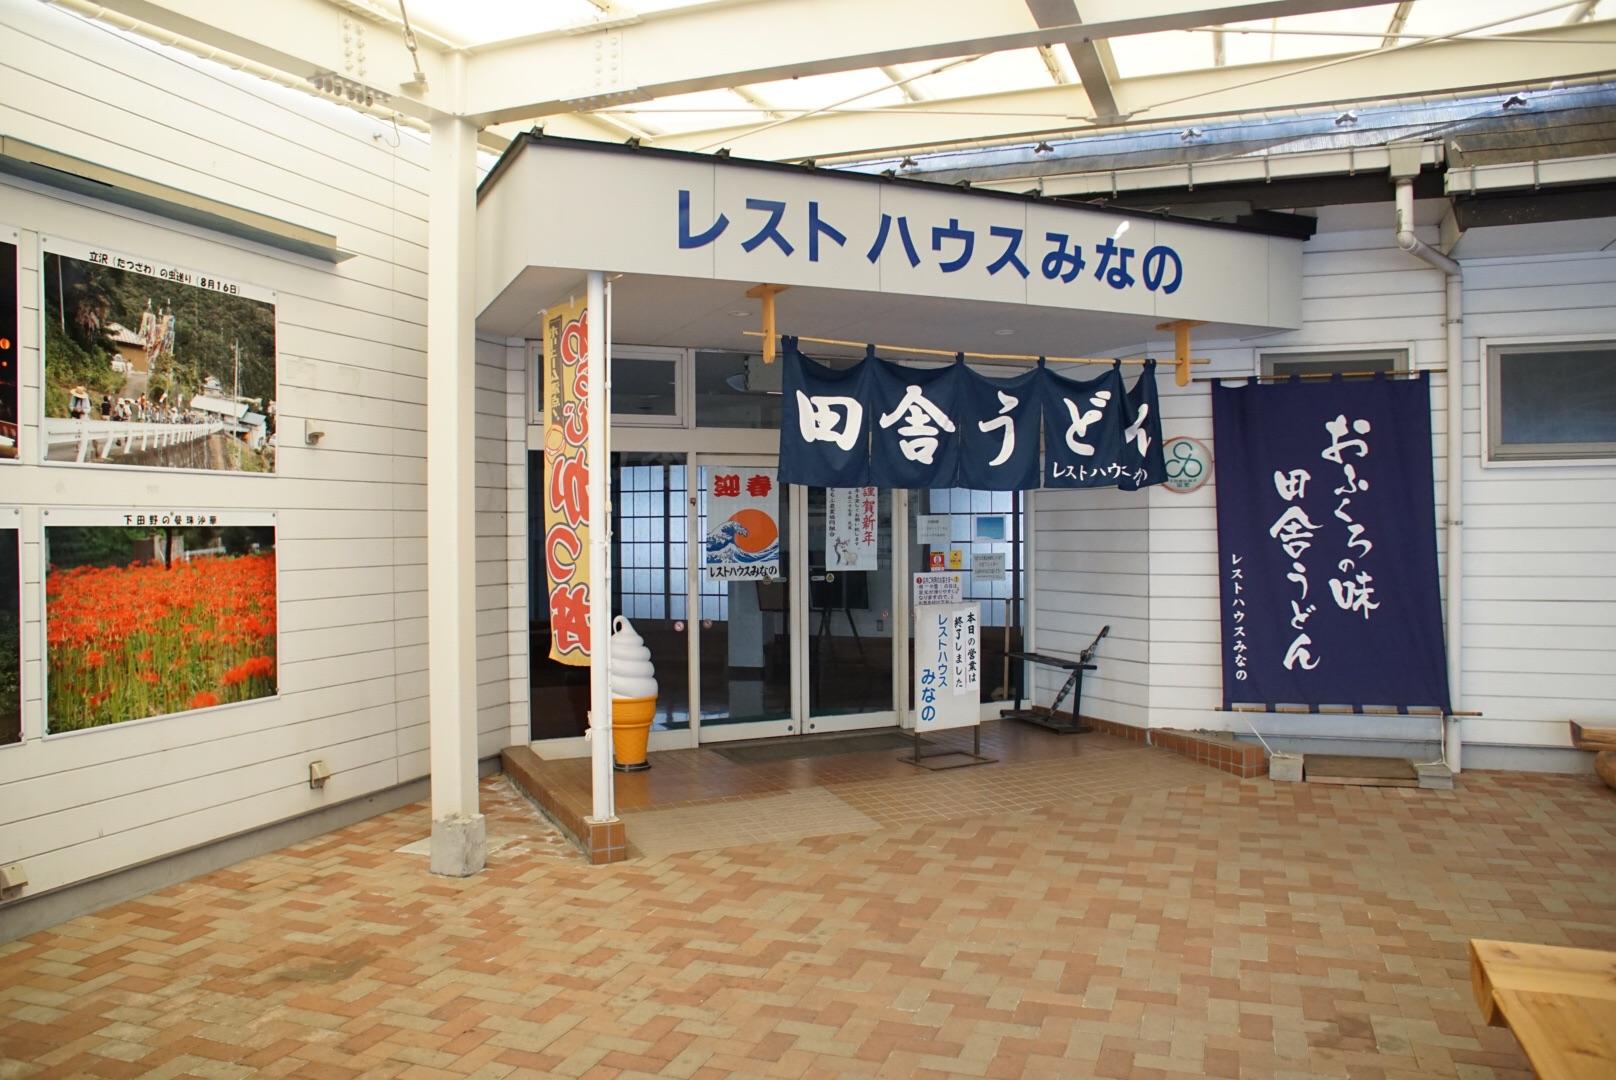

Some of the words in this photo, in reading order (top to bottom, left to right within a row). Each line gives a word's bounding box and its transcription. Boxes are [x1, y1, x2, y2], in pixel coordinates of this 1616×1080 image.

[678, 189, 1183, 295] レストハウスみなの
[713, 474, 772, 498] 迎春
[1322, 414, 1380, 620] おふくろの味
[710, 565, 778, 578] レストハウスみなの
[1269, 468, 1324, 671] 田舎うどん
[938, 614, 948, 687] レストハウス
[954, 616, 964, 688] 終了しました
[966, 611, 977, 683] 本日の営業は
[1231, 553, 1248, 682] レストハウスみなの
[921, 668, 936, 722] みなの
